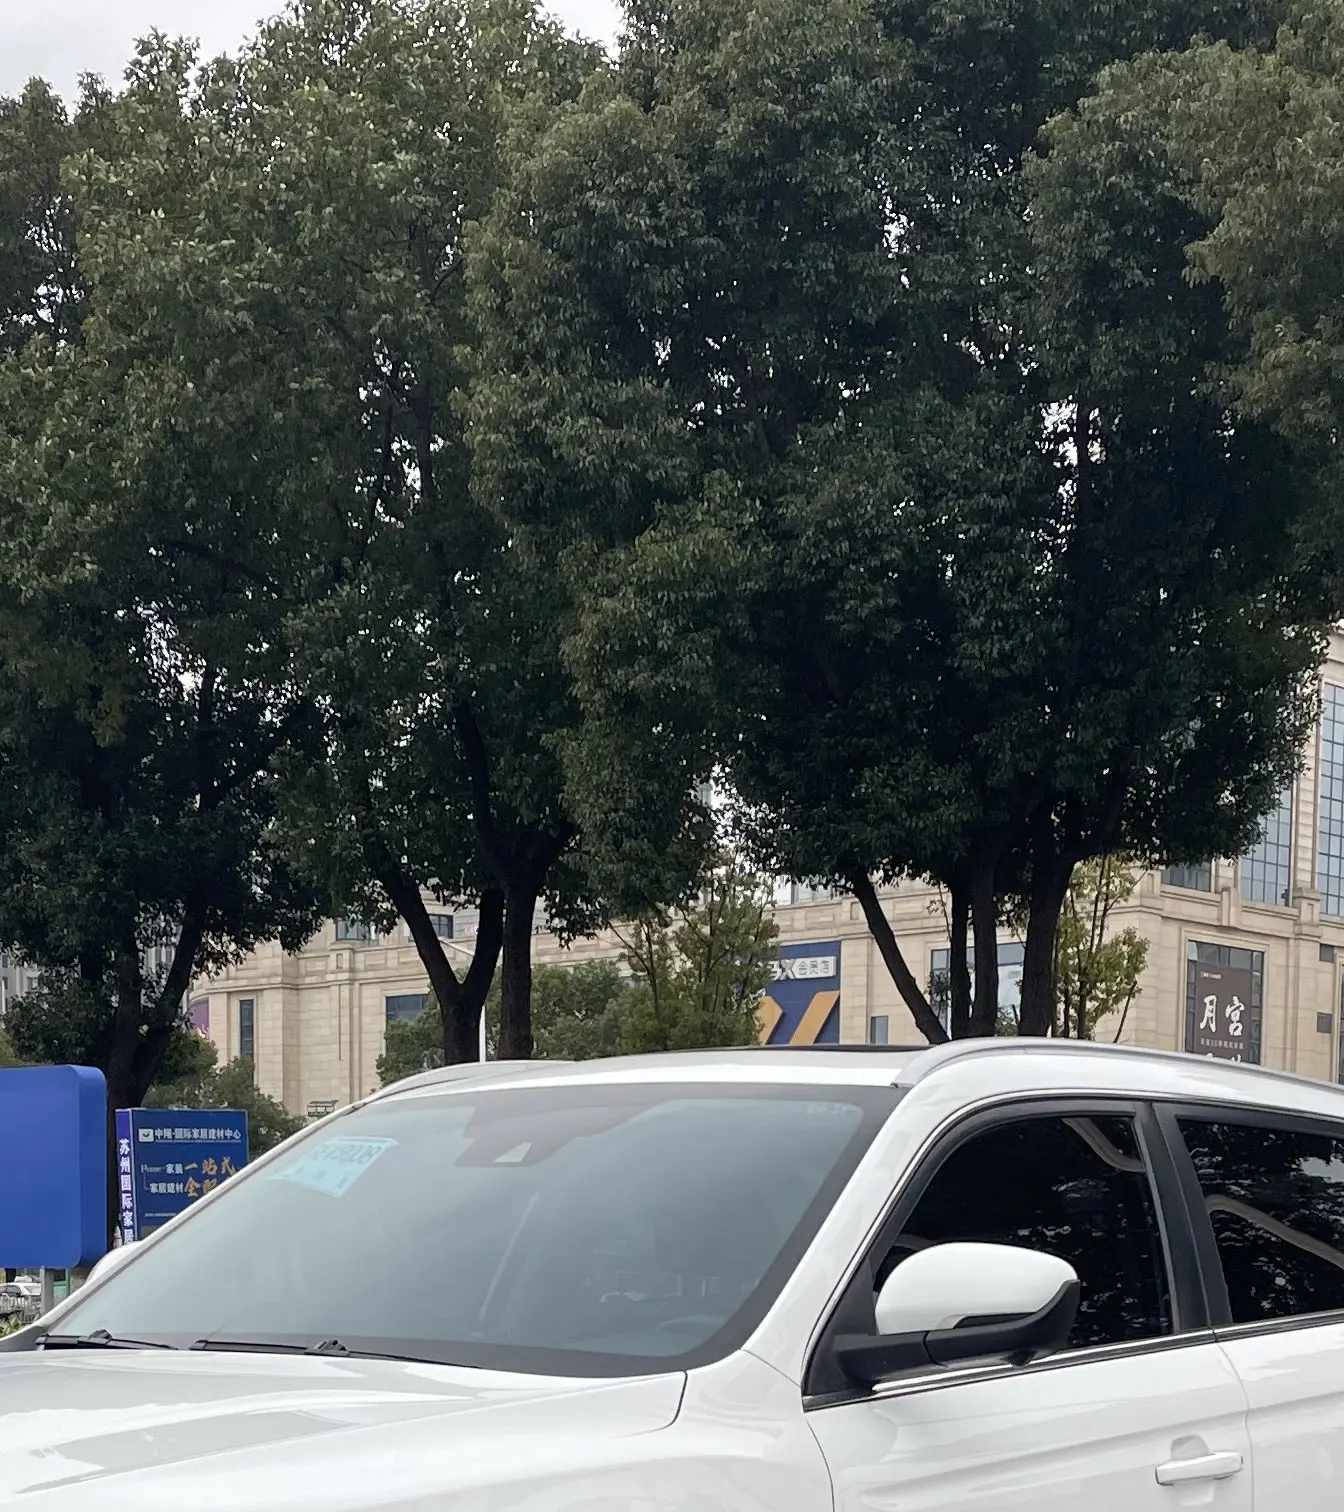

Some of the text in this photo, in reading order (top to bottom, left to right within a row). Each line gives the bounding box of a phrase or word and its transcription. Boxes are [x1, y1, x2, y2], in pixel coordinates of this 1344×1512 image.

[1199, 994, 1245, 1037] 月宫
[149, 1176, 228, 1198] 家居建材全配
